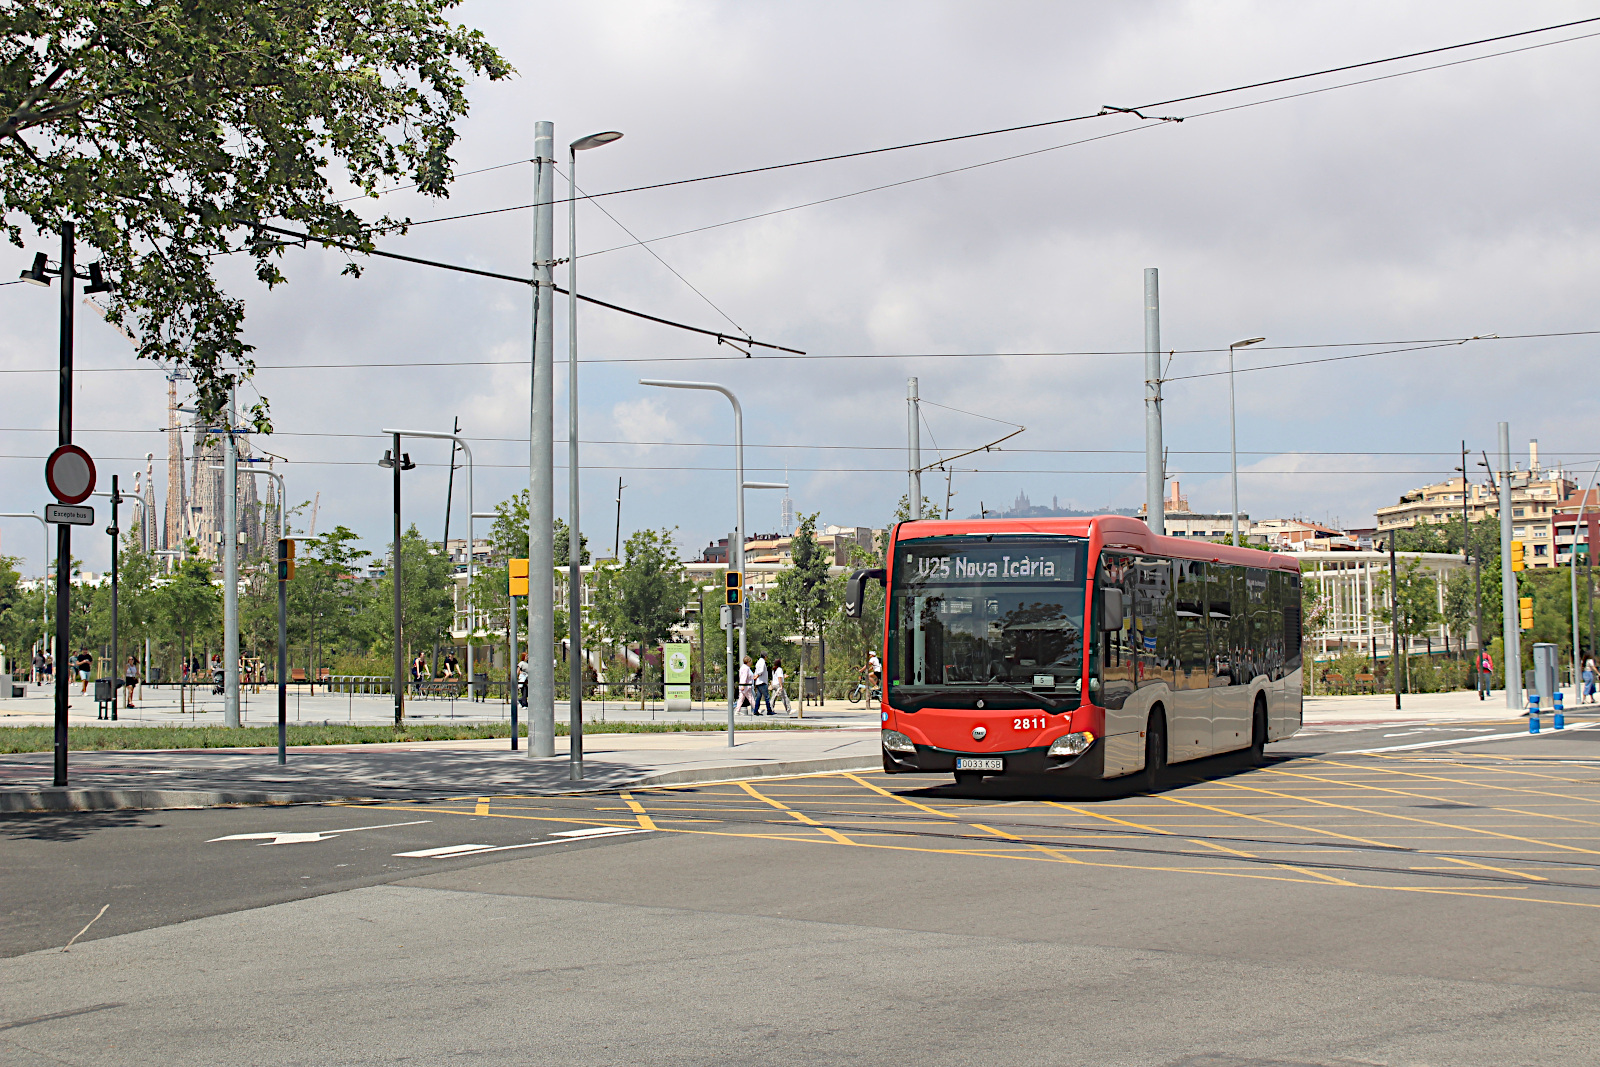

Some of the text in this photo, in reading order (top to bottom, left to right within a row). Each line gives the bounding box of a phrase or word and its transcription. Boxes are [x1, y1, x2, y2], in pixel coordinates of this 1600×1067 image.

[918, 555, 1055, 579] V25 Nova Icària
[1013, 717, 1047, 730] 2811
[962, 760, 1001, 769] 0033 KSB
